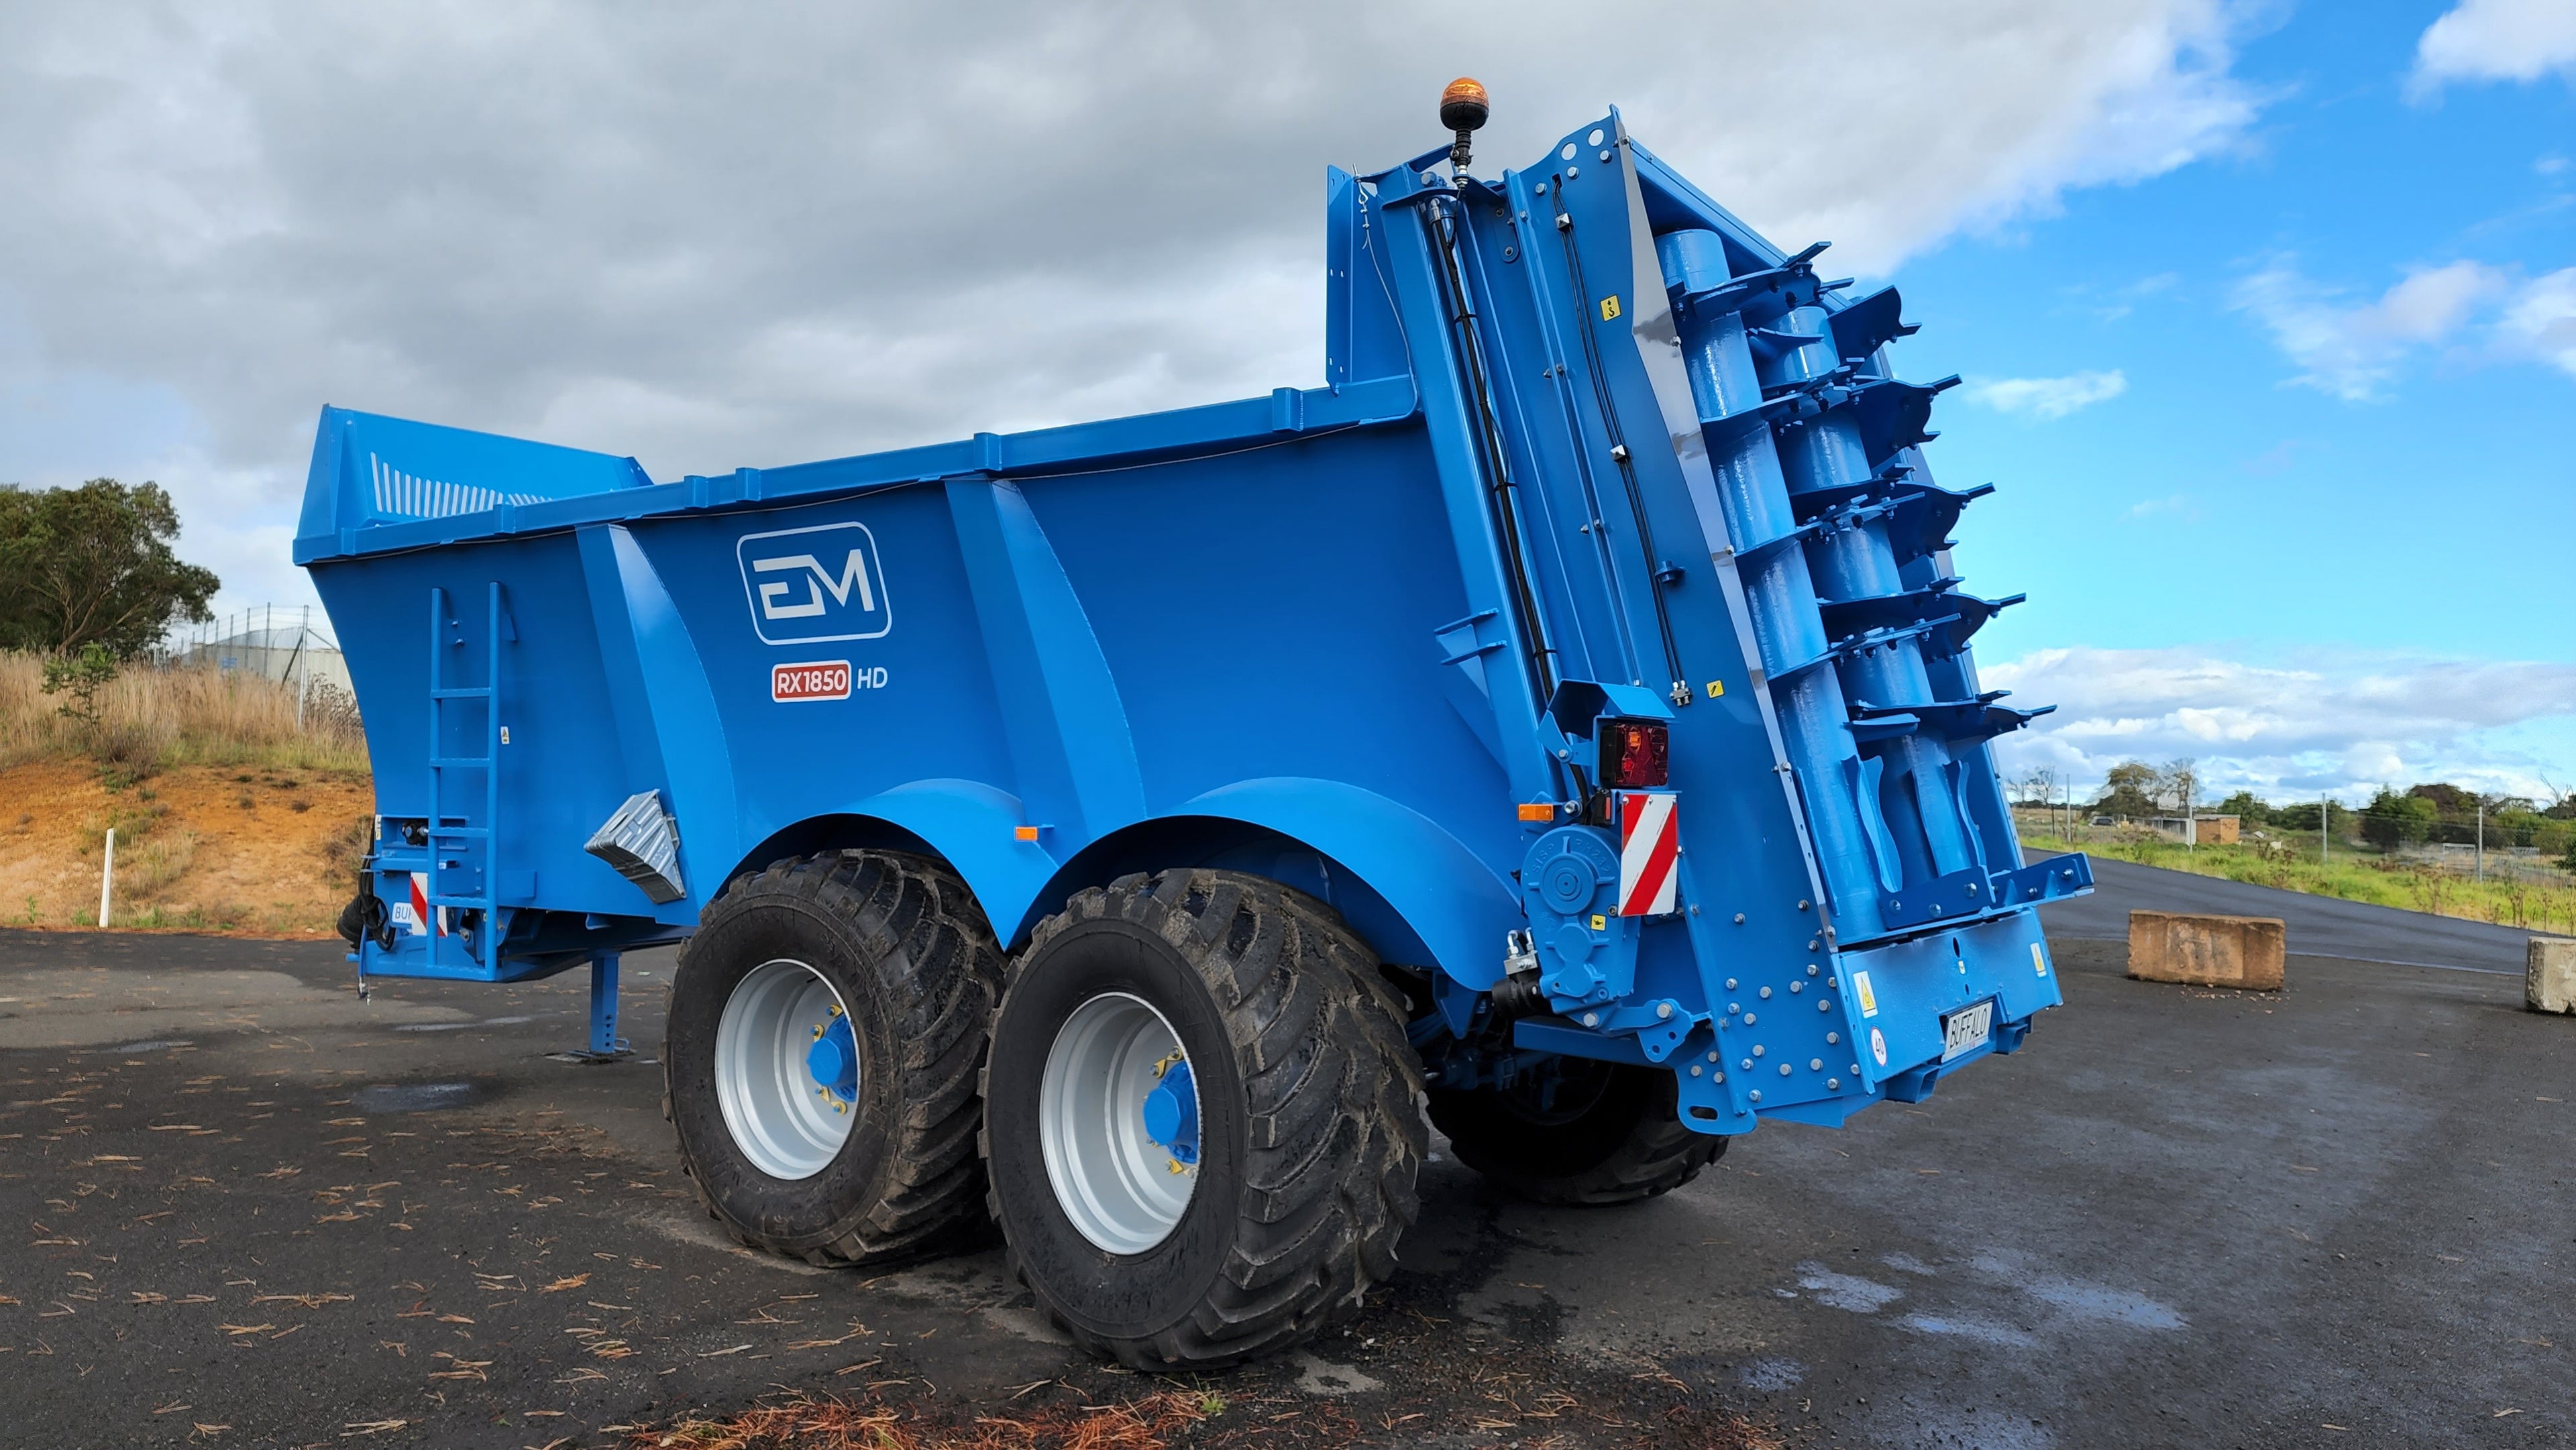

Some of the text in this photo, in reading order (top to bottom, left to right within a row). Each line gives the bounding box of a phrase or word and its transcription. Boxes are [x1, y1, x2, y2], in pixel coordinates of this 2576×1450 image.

[753, 549, 875, 620] EM
[777, 667, 888, 693] RX1850 HD
[1949, 1007, 1987, 1049] BUFFALO
[1875, 1038, 1884, 1056] 40
